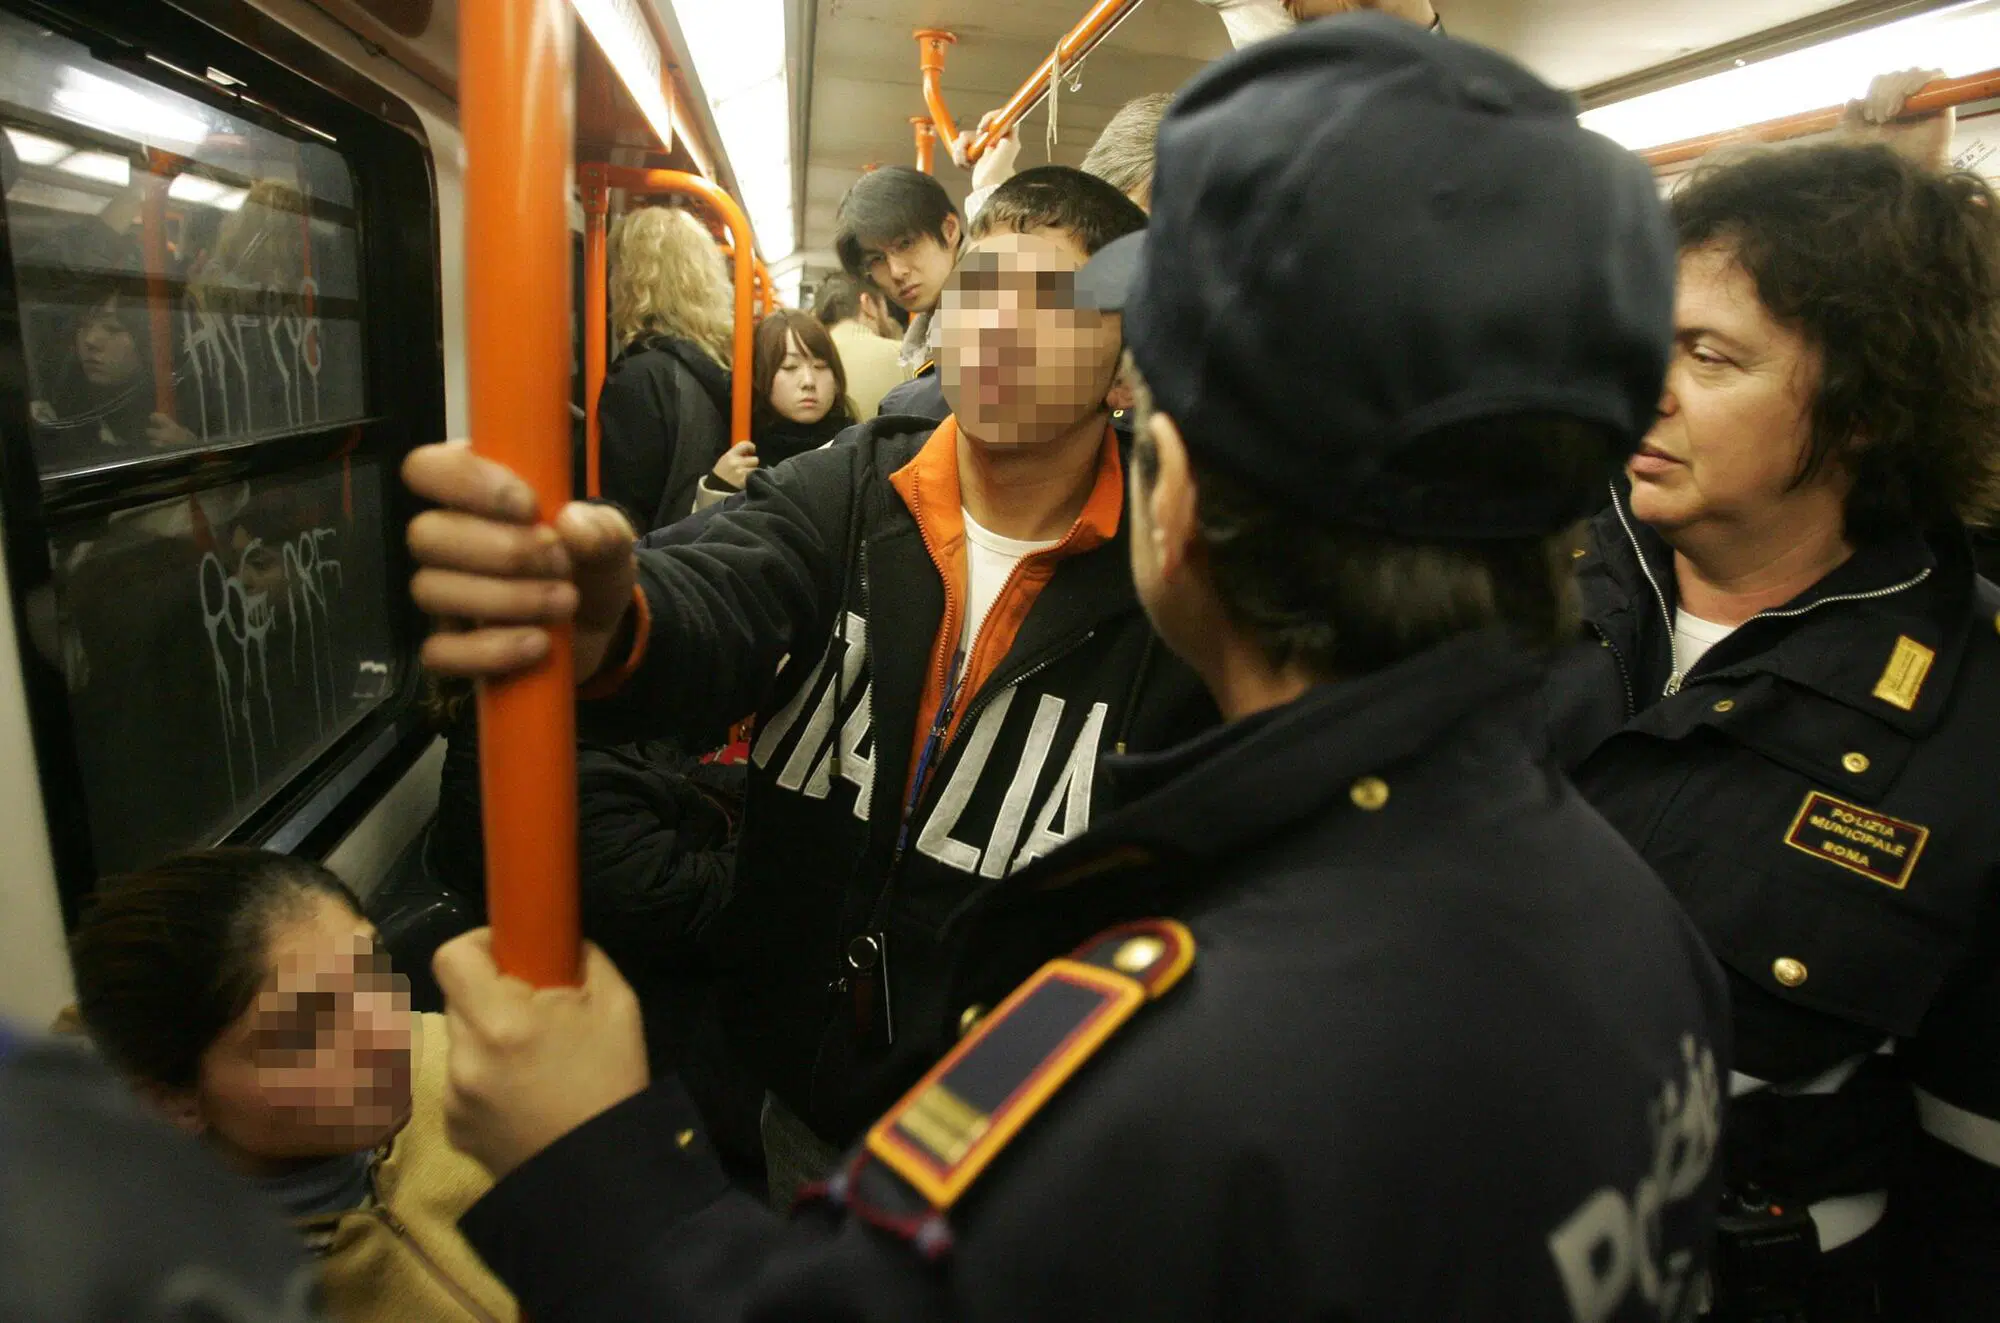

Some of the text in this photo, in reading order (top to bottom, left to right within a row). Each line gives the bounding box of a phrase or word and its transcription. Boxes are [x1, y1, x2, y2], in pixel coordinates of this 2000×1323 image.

[1809, 816, 1906, 856] MUNICIPALE
[1832, 808, 1894, 837] POLIZIA
[1823, 841, 1869, 866] ROMA
